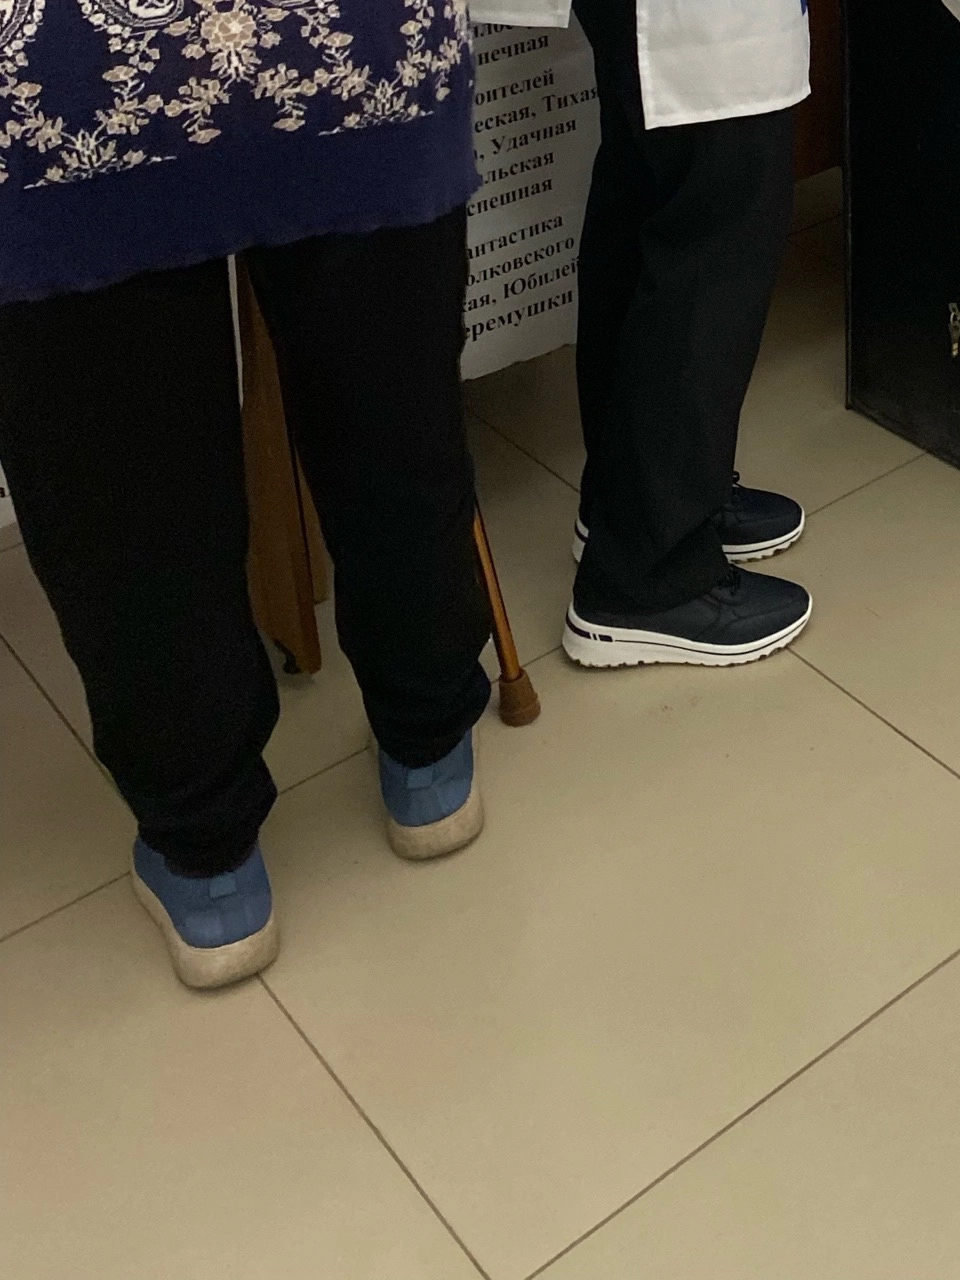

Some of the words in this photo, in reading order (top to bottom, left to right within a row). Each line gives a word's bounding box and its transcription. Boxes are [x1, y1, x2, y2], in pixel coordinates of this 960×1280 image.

[475, 68, 555, 106] оителей
[491, 119, 577, 156] Удачная
[467, 179, 553, 217] спешная
